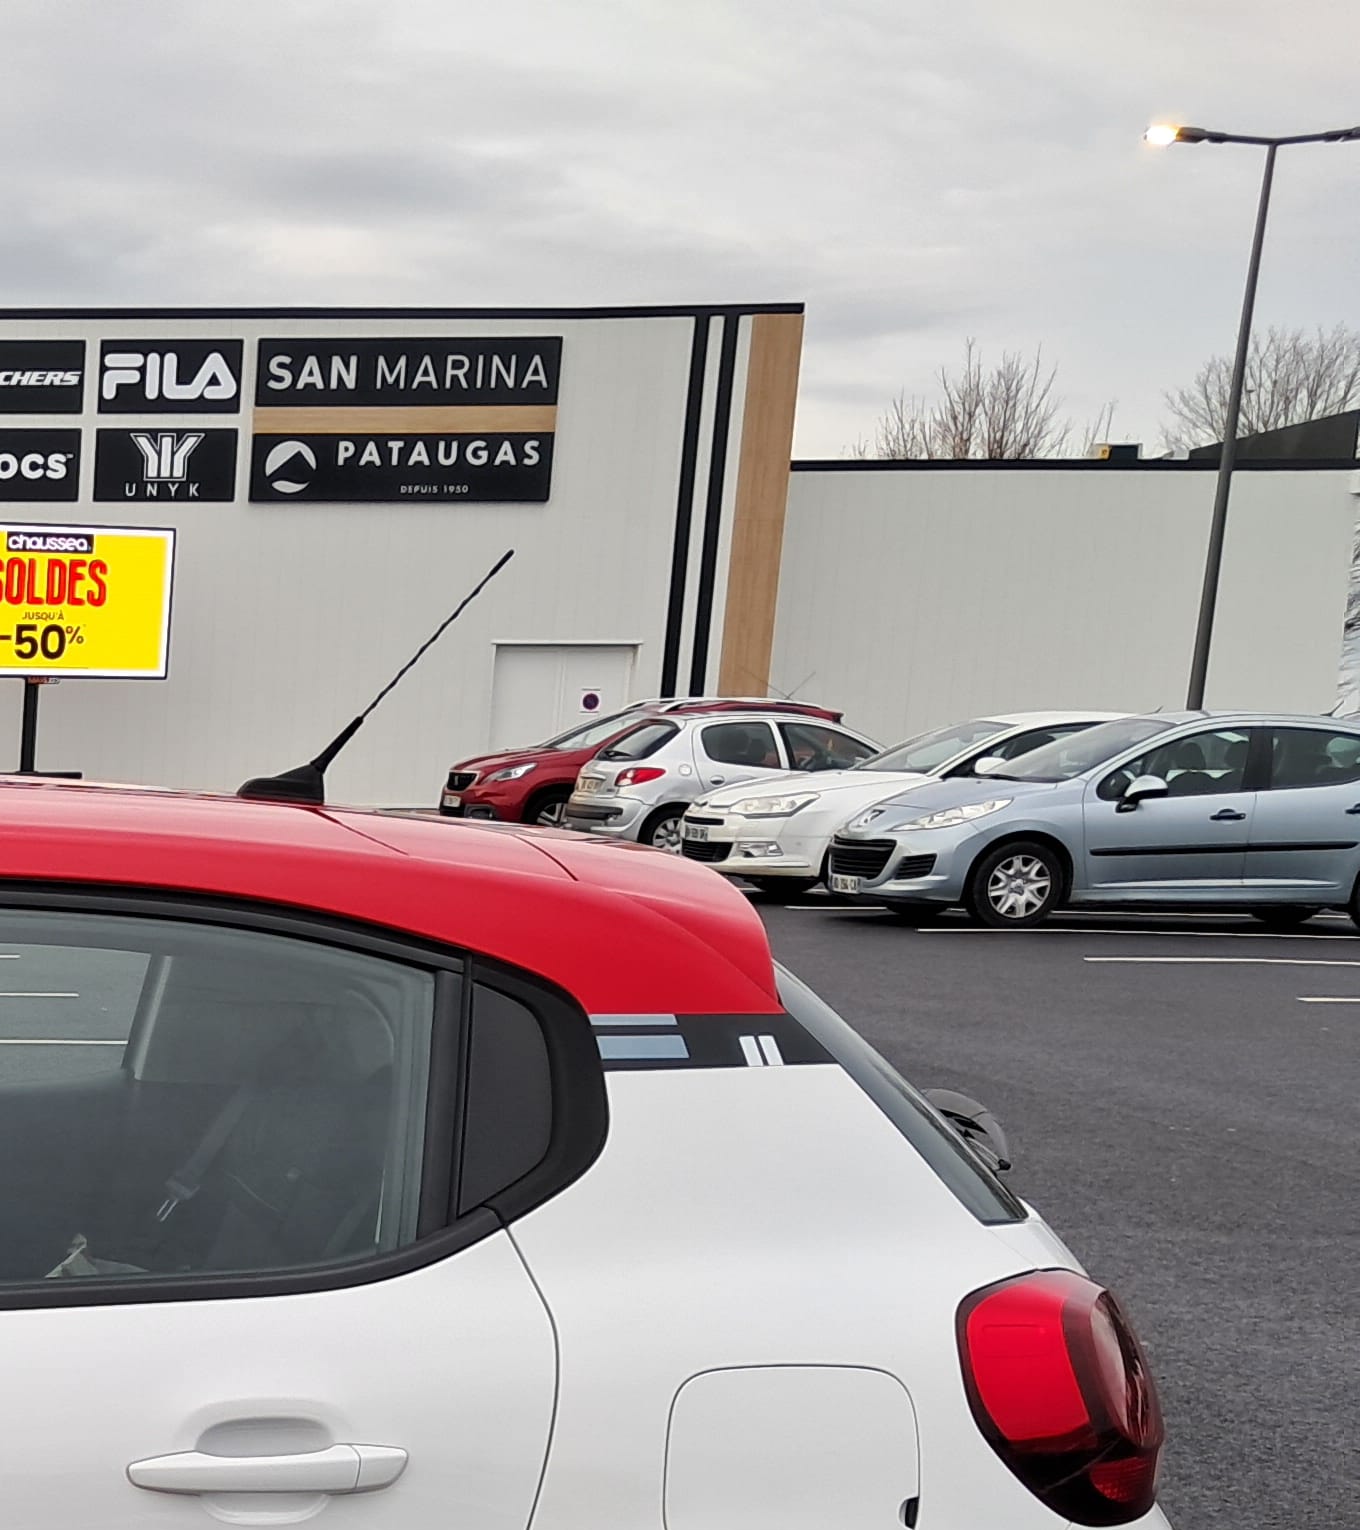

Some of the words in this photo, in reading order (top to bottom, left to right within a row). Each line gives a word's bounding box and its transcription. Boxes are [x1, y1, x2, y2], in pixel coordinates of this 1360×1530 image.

[102, 352, 237, 400] FILA
[266, 355, 358, 390] SAN
[375, 354, 548, 390] MARINA
[337, 440, 541, 467] PATAUGAS
[125, 482, 200, 498] UNYK
[399, 484, 439, 494] DEPUIS
[442, 484, 470, 494] 1950
[22, 610, 65, 621] JUSQU'À
